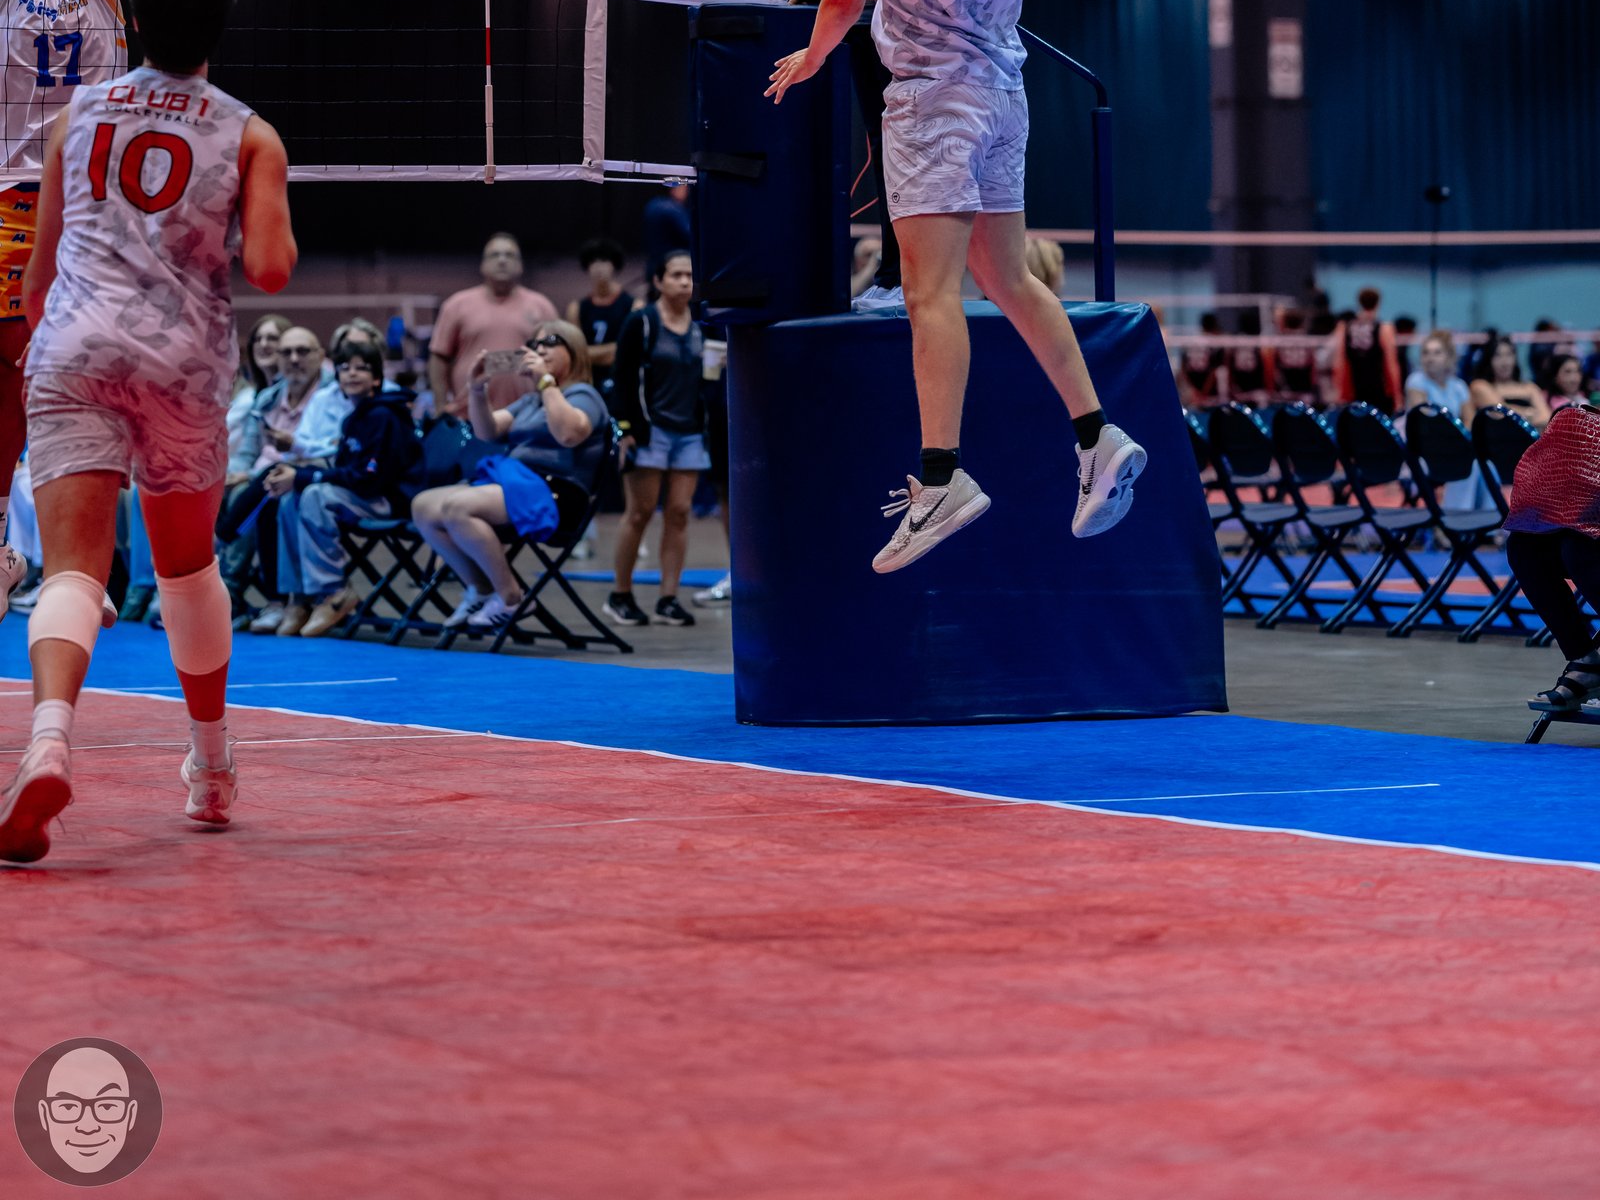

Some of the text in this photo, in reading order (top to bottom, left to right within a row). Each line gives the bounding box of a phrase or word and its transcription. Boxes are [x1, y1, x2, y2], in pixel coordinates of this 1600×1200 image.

[33, 31, 83, 87] 17
[104, 104, 200, 126] VOLLEYBALL
[107, 85, 191, 112] CLUB
[88, 122, 193, 214] 10
